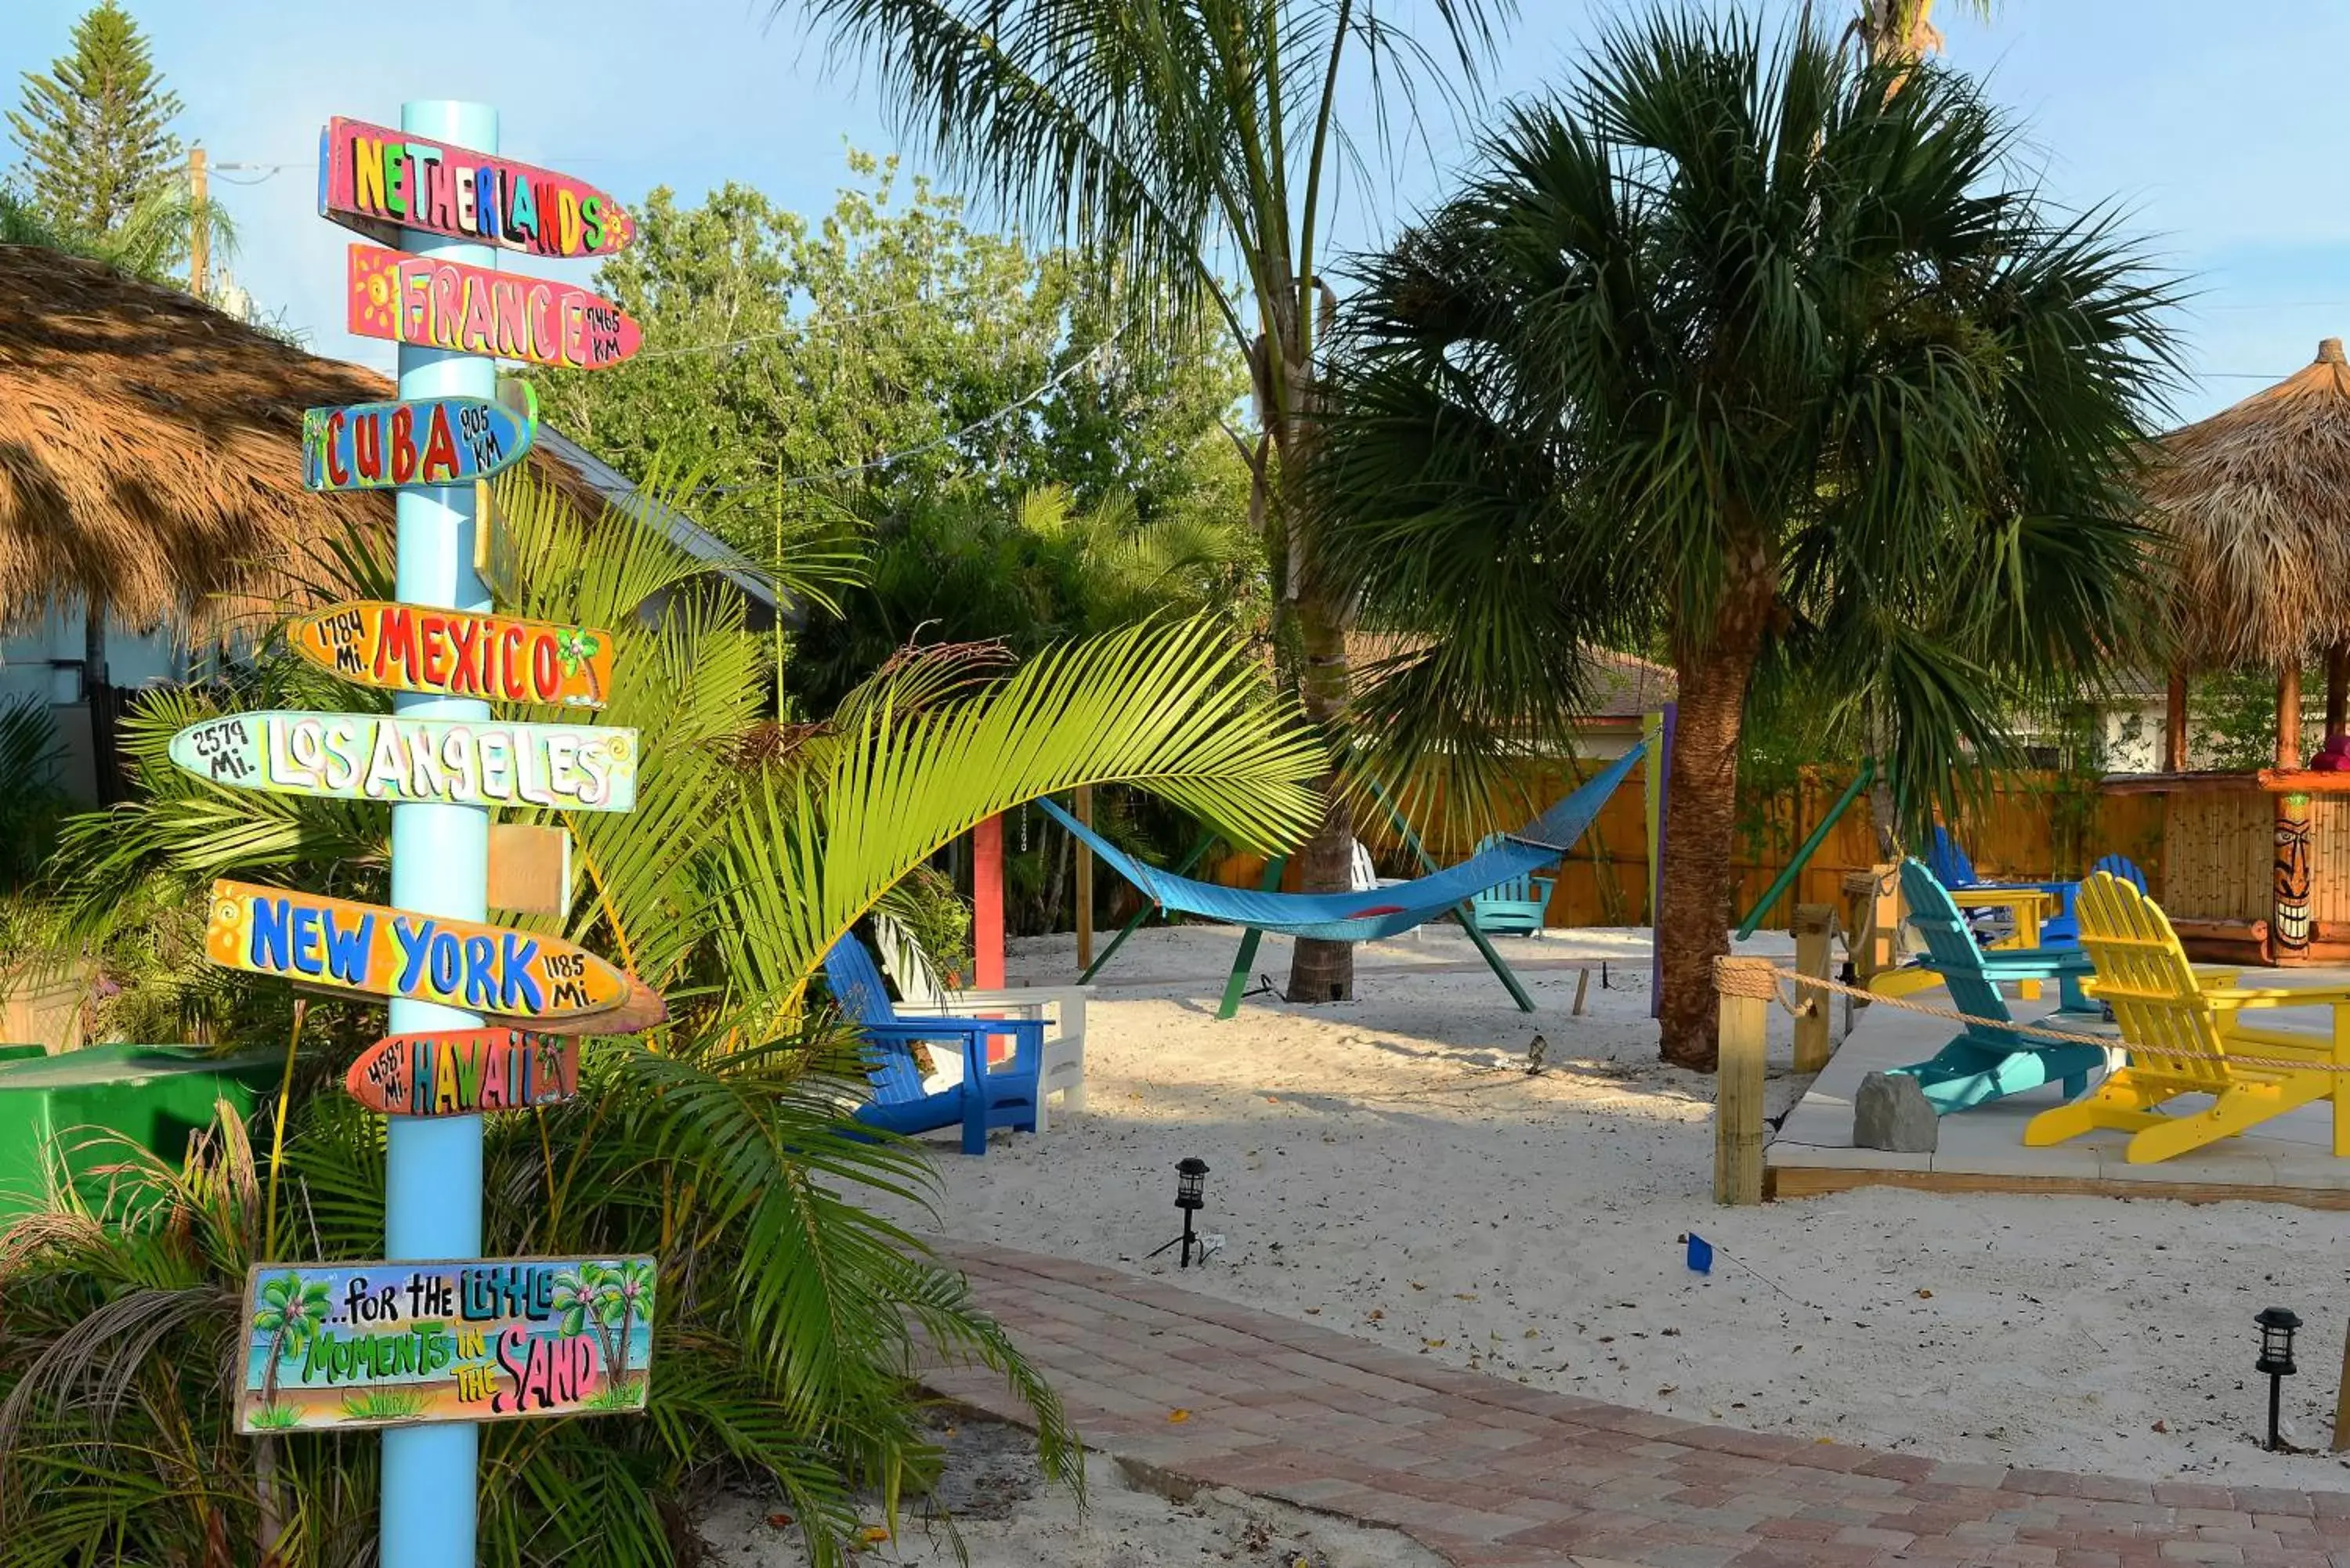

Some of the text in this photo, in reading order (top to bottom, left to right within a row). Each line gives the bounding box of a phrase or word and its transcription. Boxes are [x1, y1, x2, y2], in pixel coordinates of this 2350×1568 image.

[352, 136, 606, 256] NETHERLANDS
[396, 258, 586, 367] FRANCE
[592, 337, 621, 362] KM
[326, 403, 461, 486] CUBA
[461, 404, 489, 441] 805
[471, 430, 503, 473] KM
[317, 609, 365, 645] 1784
[192, 720, 249, 756] 2579
[266, 716, 363, 790] LOS
[249, 897, 544, 1015] NEW YORK
[543, 952, 585, 978] 1185
[367, 1040, 404, 1085] 4587
[302, 1321, 450, 1384] MOMENTS
[449, 1324, 598, 1414] THE SAND
